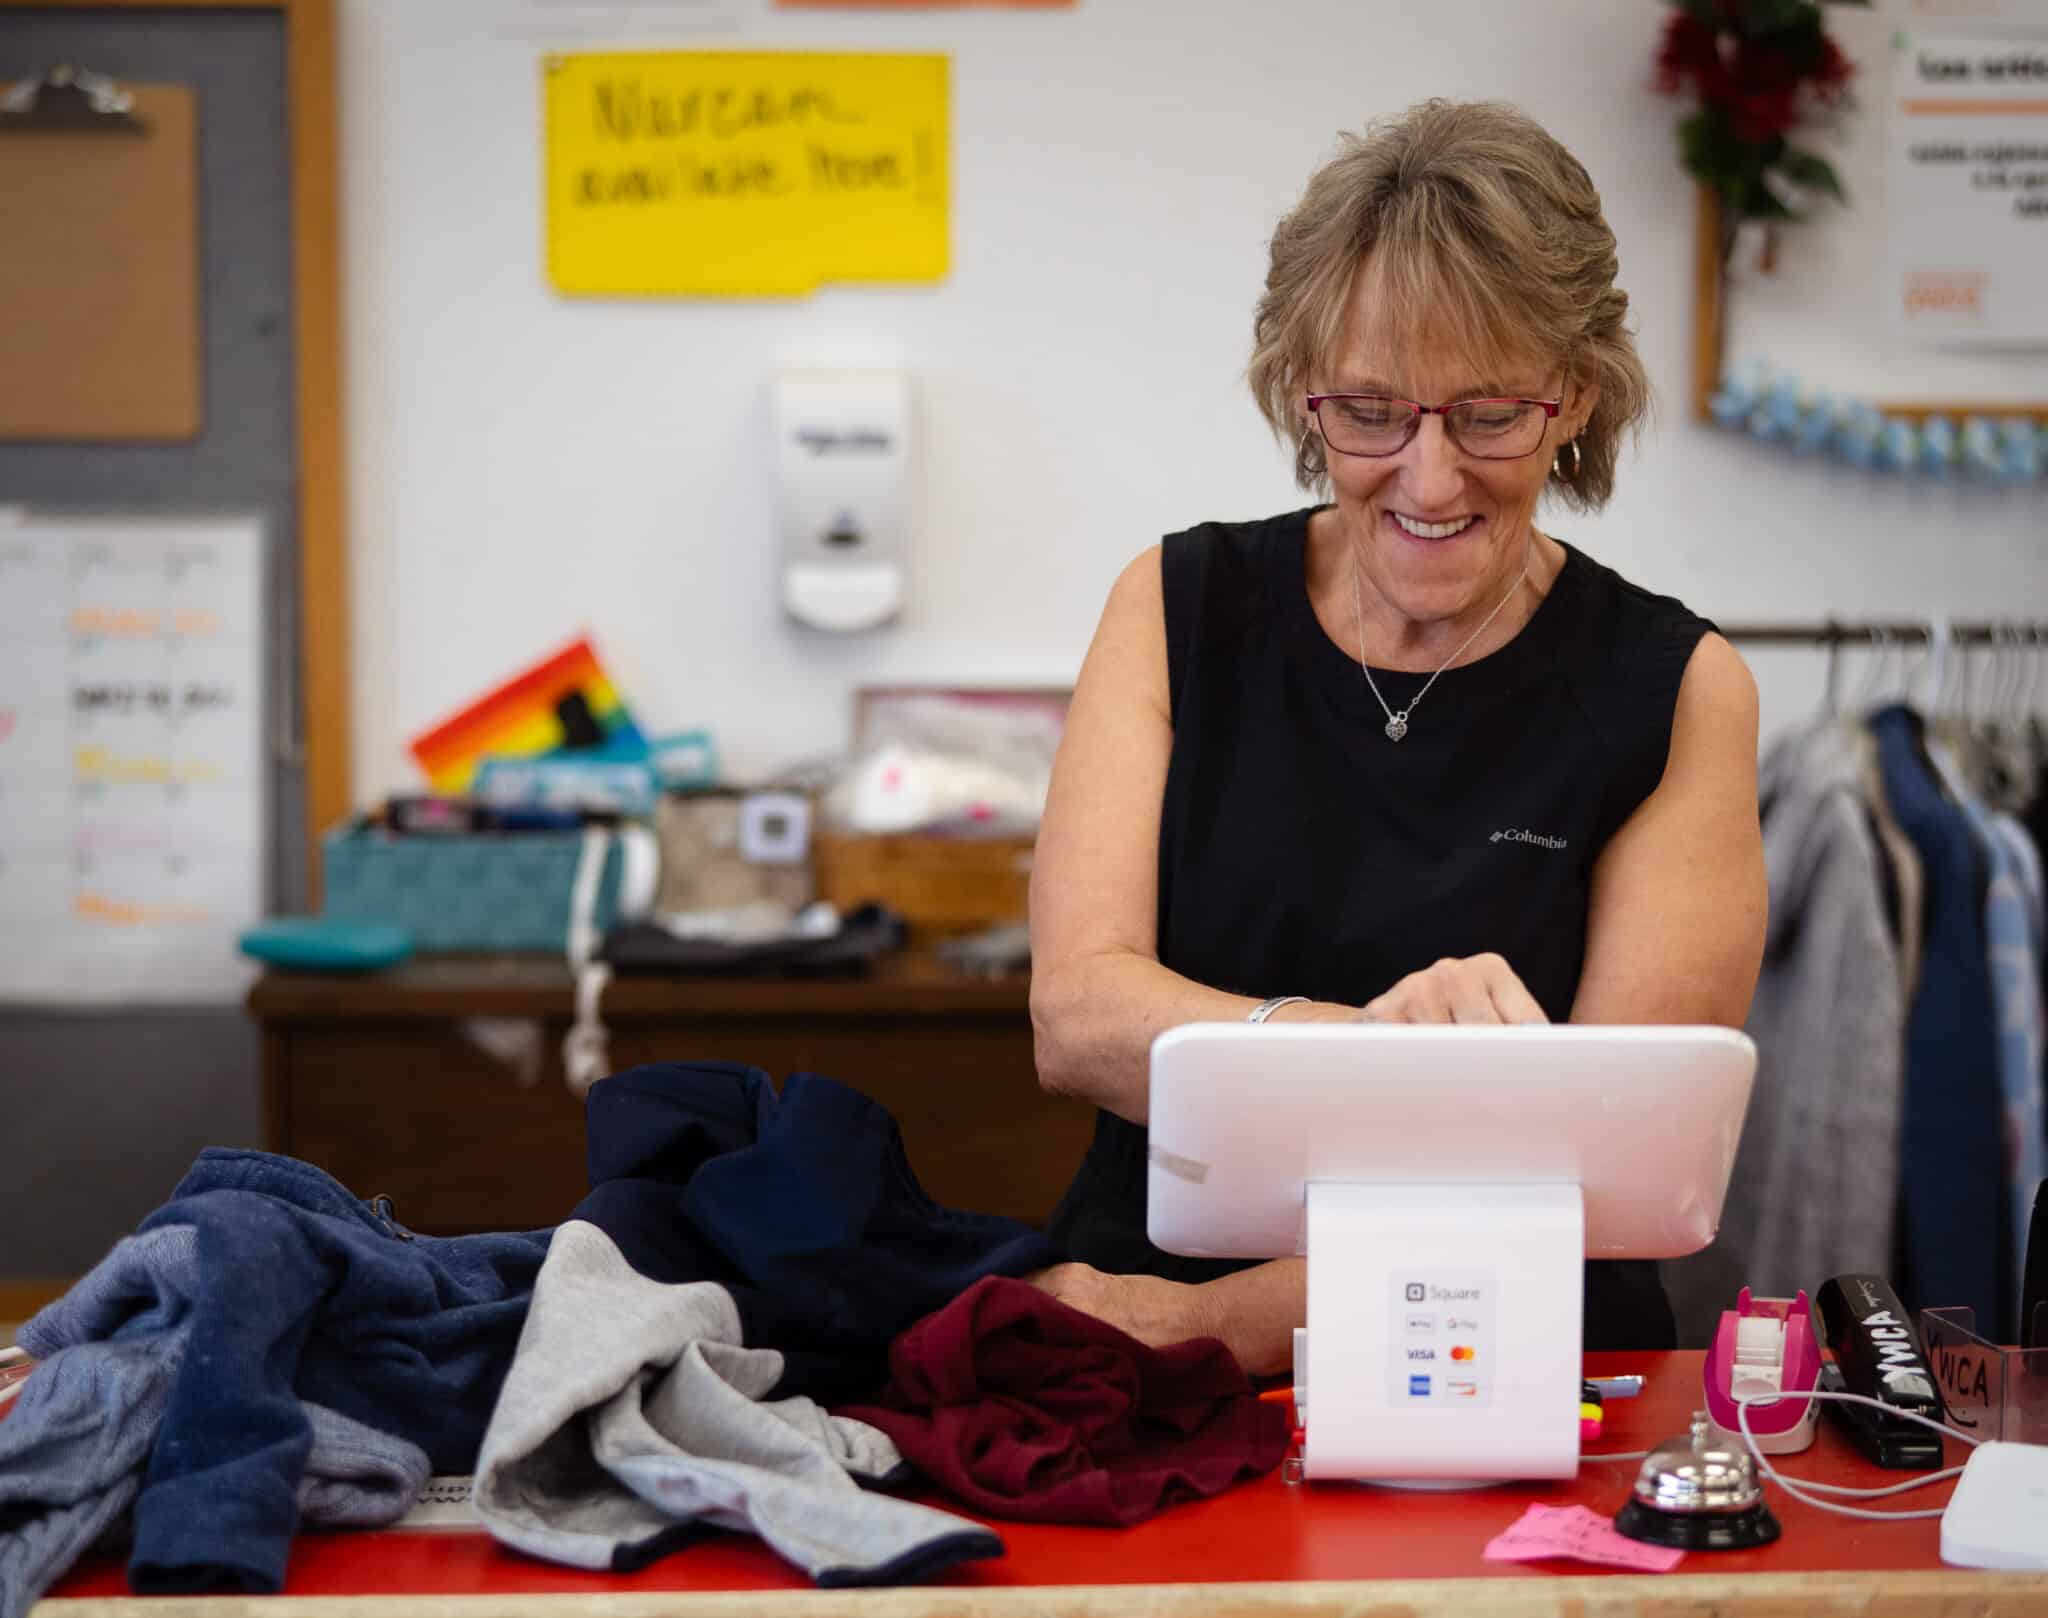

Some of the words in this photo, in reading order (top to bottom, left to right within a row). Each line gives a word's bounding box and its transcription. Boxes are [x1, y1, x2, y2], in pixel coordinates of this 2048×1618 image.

[1503, 828, 1567, 849] Columbia
[1430, 1284, 1481, 1304] Square
[1407, 1349, 1435, 1360] VISA
[1861, 1310, 1927, 1384] YWCA
[1925, 1327, 1989, 1408] YWCA
